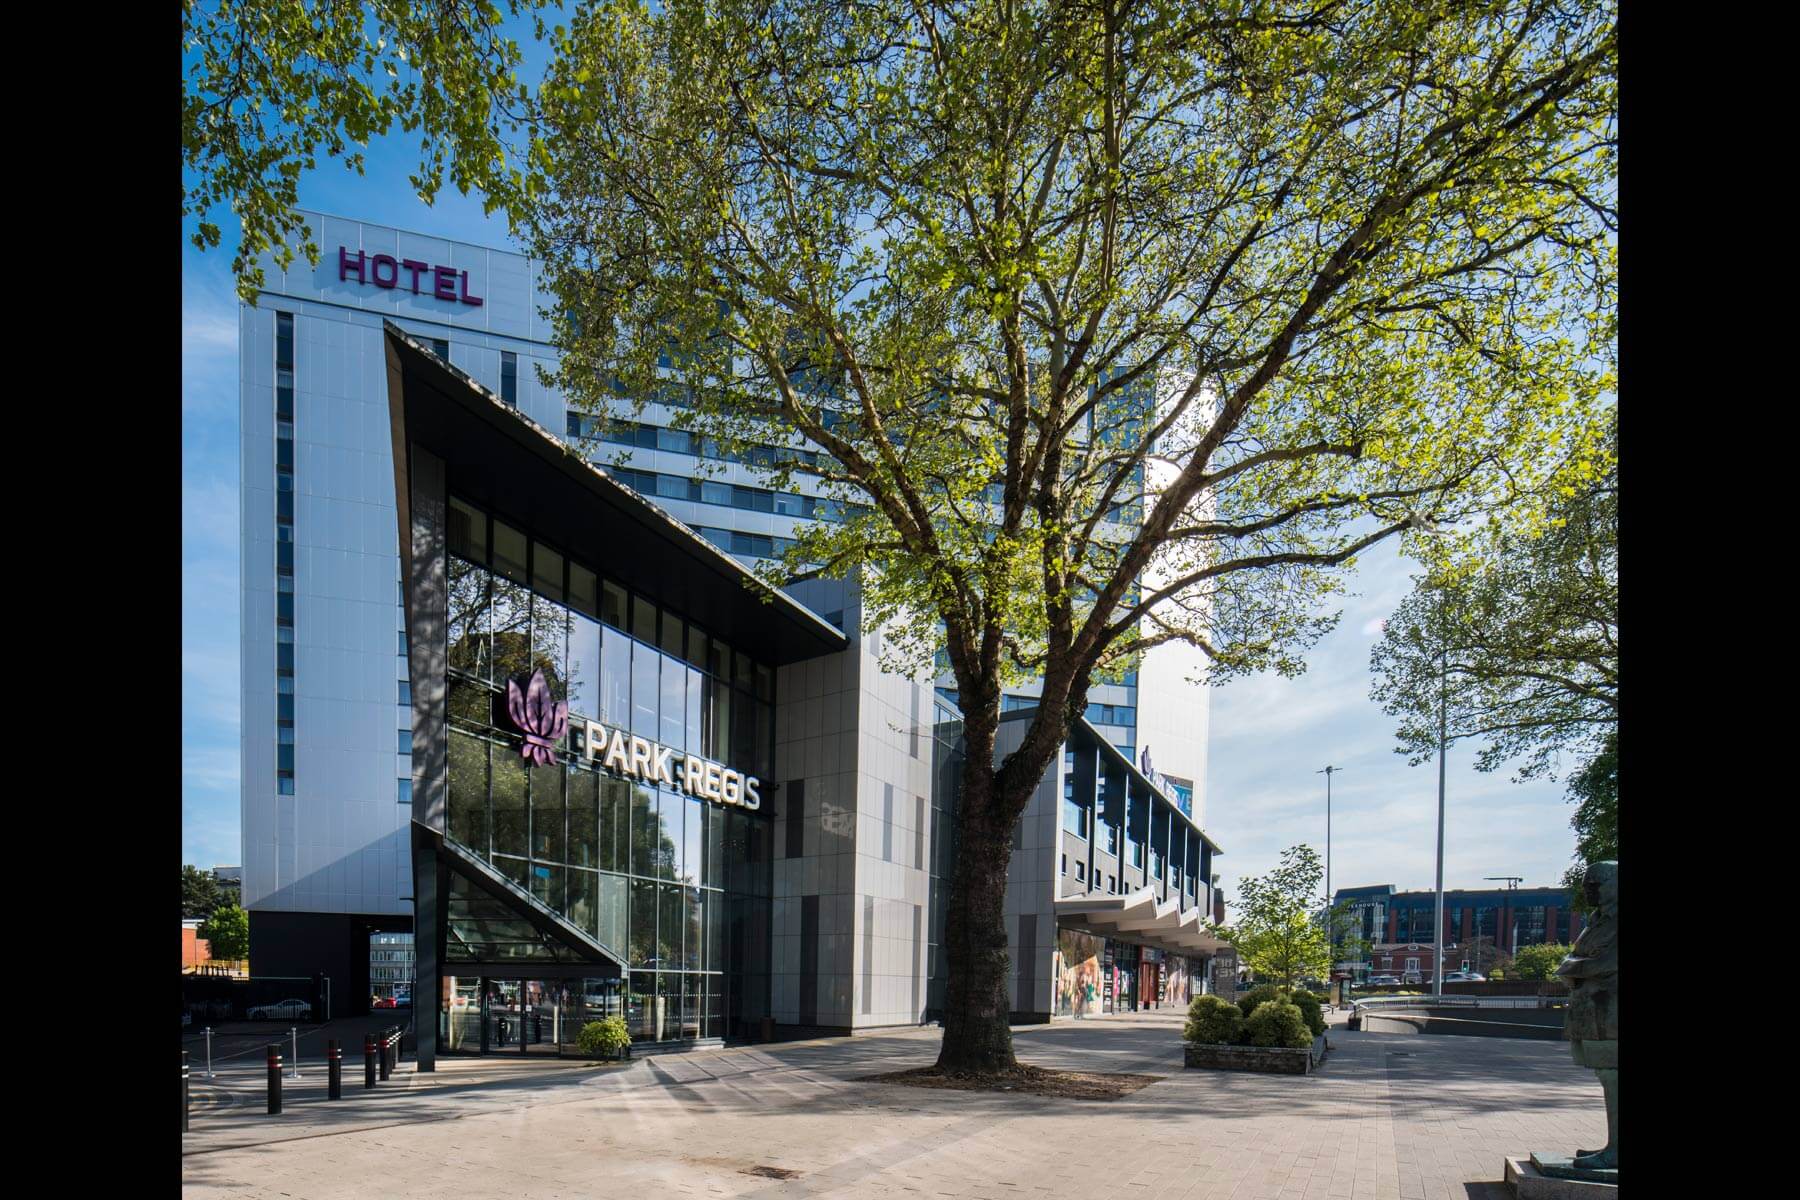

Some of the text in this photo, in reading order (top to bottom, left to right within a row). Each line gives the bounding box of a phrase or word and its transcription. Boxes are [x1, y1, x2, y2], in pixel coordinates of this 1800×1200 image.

[339, 246, 483, 306] HOTEL
[584, 720, 760, 809] PARK REGIS
